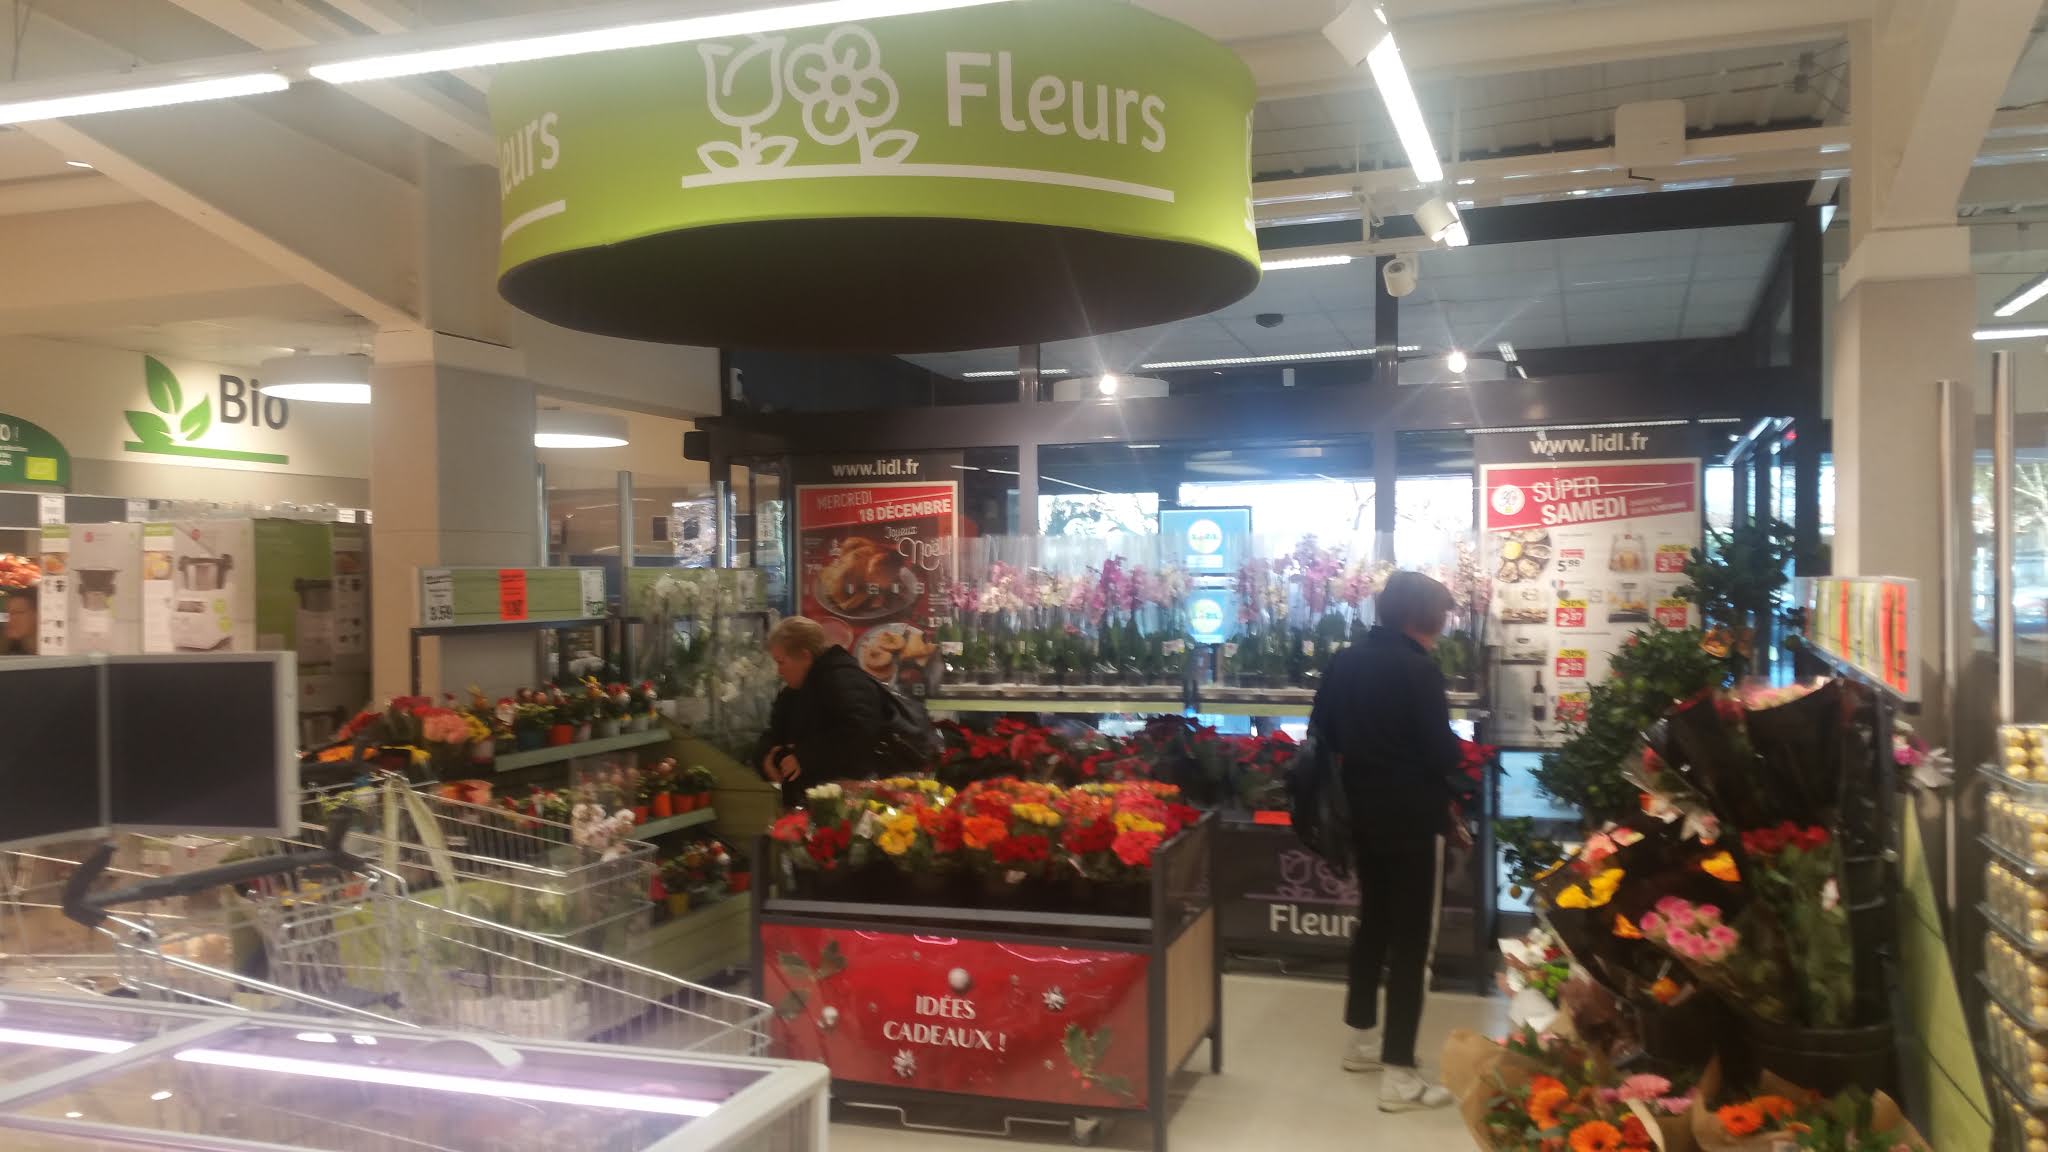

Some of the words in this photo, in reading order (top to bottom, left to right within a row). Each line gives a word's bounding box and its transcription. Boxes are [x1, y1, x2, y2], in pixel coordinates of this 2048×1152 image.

[945, 50, 1166, 153] Fleurs
[219, 374, 290, 430] Bio
[1529, 432, 1648, 455] www.lidl.fr
[832, 458, 919, 477] www.lidl.fr
[816, 490, 872, 510] MERCREDI
[1531, 476, 1601, 503] SUPER
[858, 507, 874, 522] 18
[876, 498, 951, 521] DÉCEMBRE
[1541, 496, 1627, 525] SAMEDI
[1269, 903, 1361, 938] Fleur
[915, 994, 976, 1020] IDÉES
[883, 1020, 994, 1051] CADEAUX
